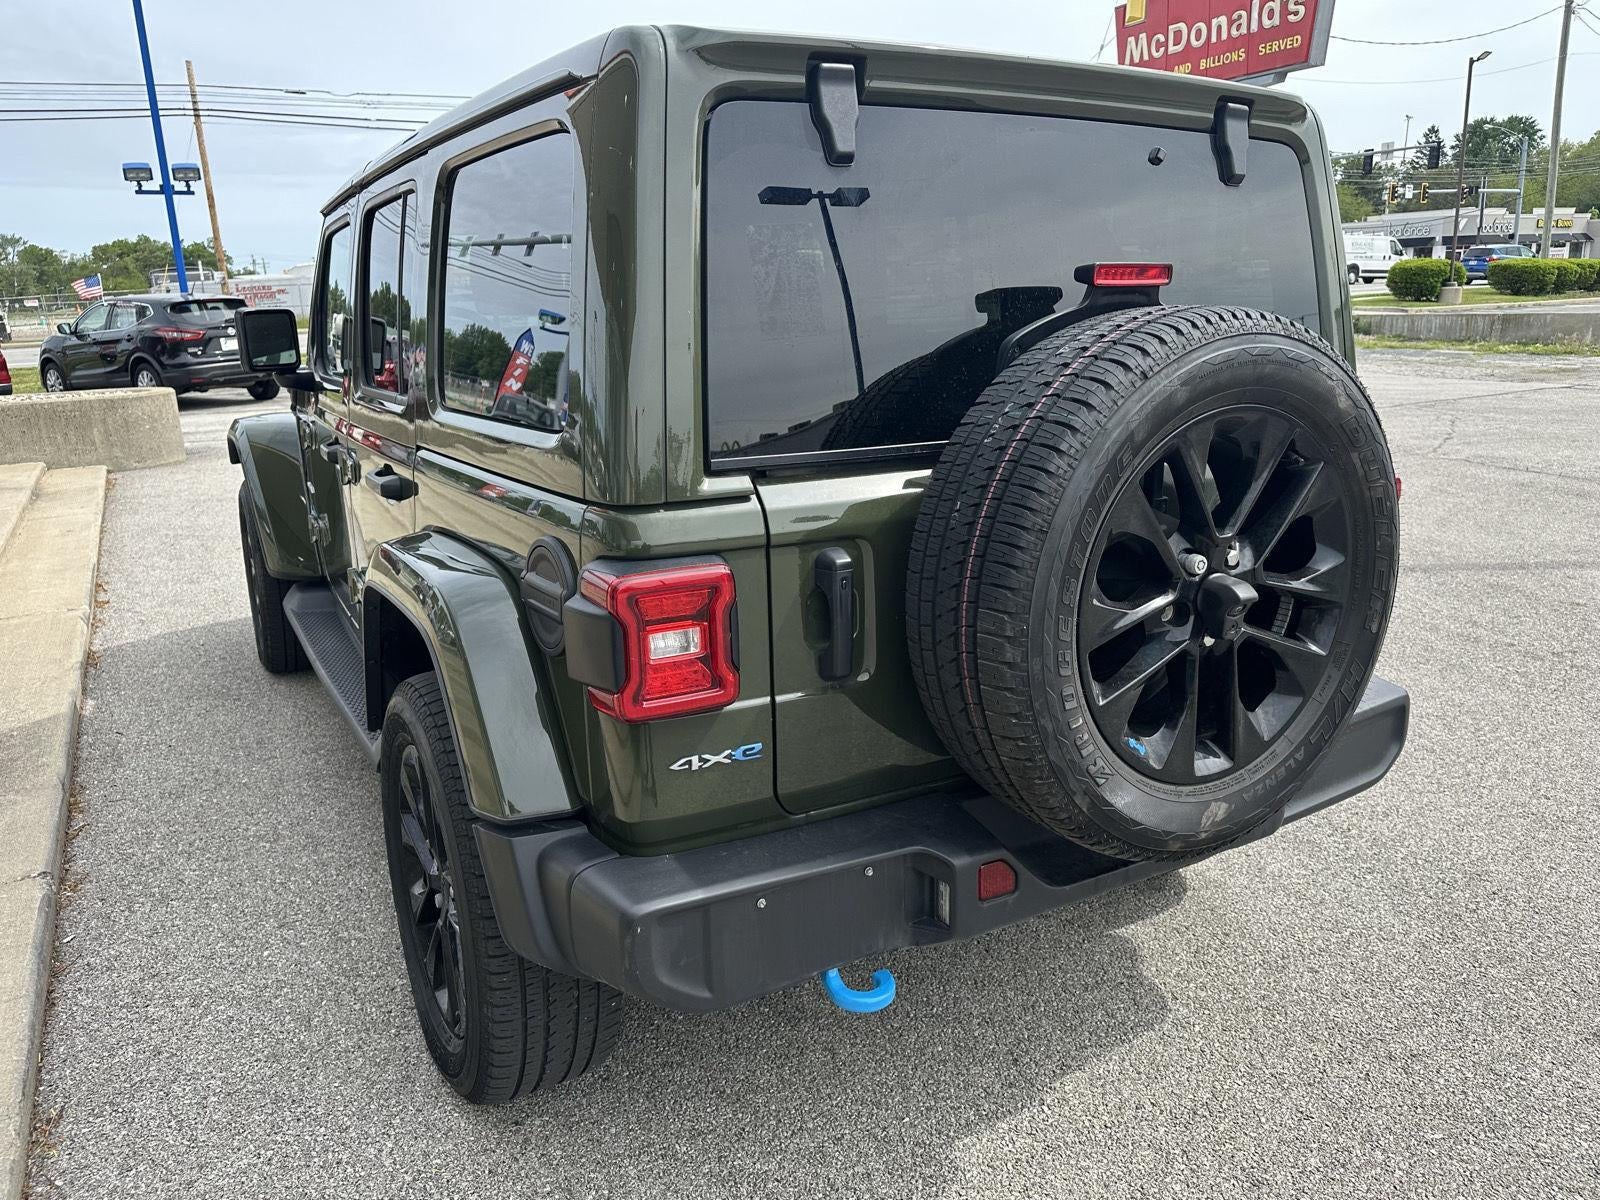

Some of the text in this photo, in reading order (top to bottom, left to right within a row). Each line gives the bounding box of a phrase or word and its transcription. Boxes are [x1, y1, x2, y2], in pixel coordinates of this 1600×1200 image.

[1125, 0, 1306, 66] McDonalds
[1199, 49, 1246, 70] BILLIONS
[1258, 35, 1302, 56] SERVED
[520, 340, 536, 357] WE
[1340, 415, 1392, 634] DUELER
[1057, 444, 1135, 788] BRIDGESTONE
